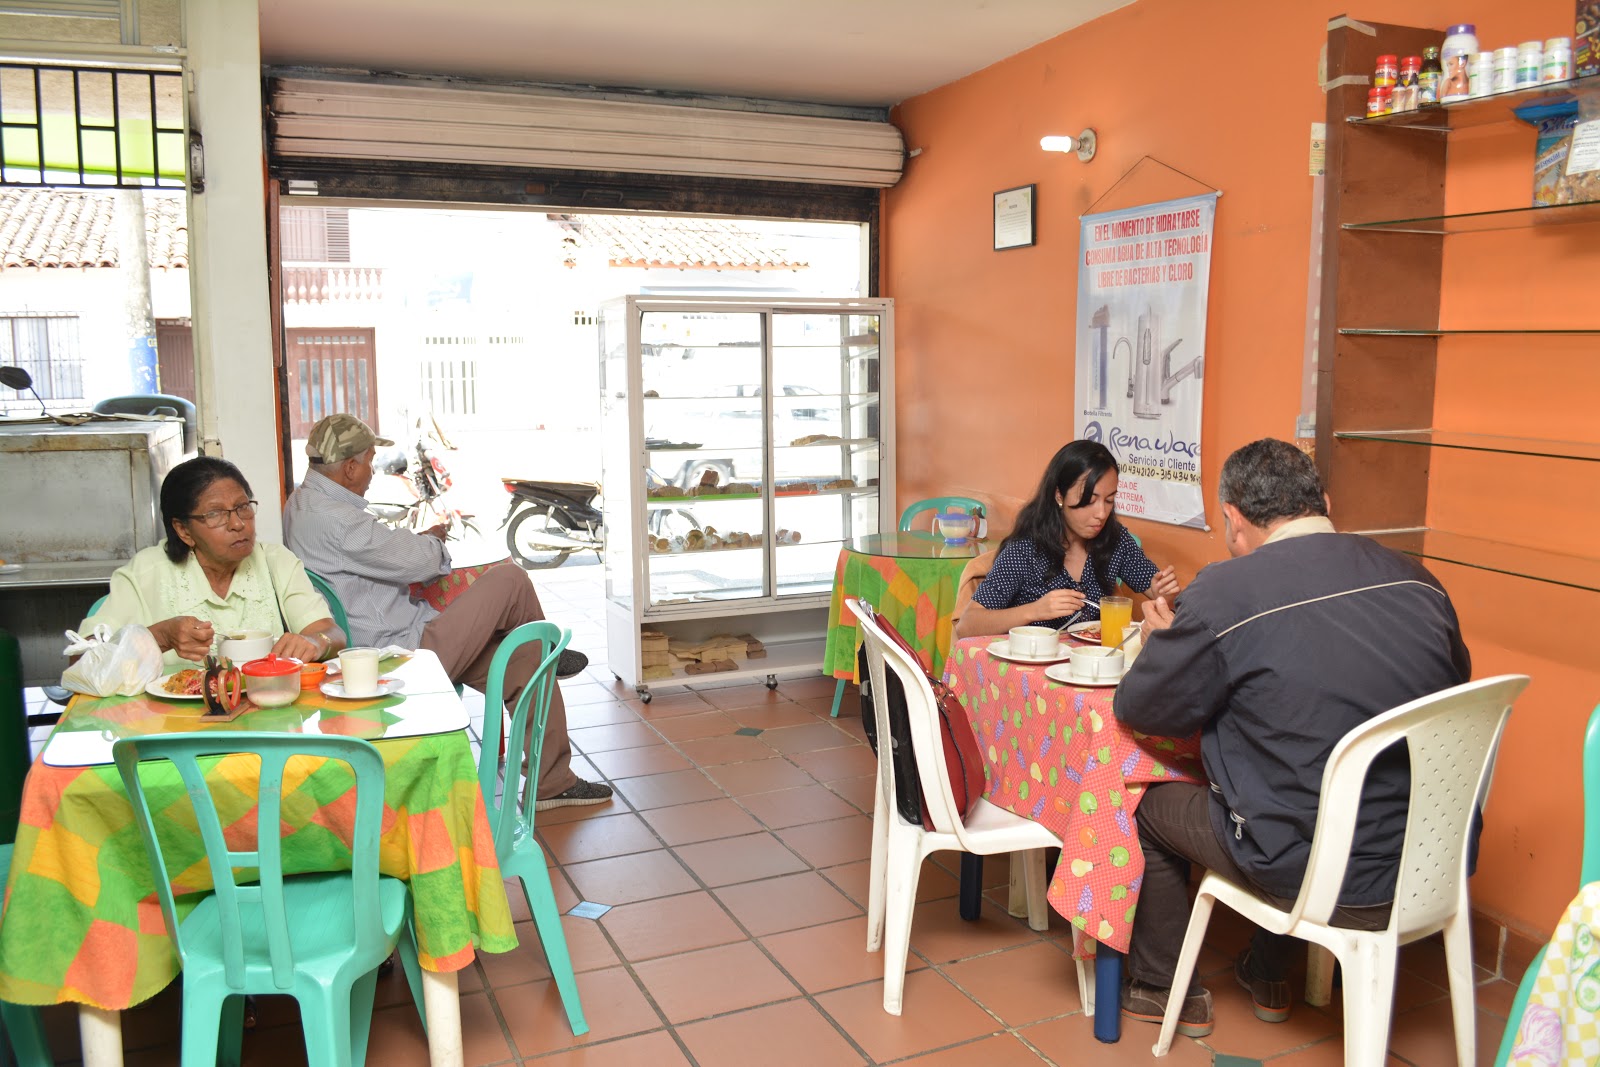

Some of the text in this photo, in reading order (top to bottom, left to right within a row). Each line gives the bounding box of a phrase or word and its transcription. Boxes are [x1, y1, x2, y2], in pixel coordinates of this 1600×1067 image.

[1095, 209, 1201, 242] EN EL MOMENTO DE HIDRATARSE
[1085, 231, 1209, 266] CONSUMA AGUA DE ALTA TECNOLOGÍA
[1098, 262, 1193, 288] LIBRE DE BACTERIAS Y CLORO
[1128, 453, 1196, 472] Servicio al Cliente
[1129, 481, 1138, 491] DE
[1125, 503, 1145, 515] OTRA!
